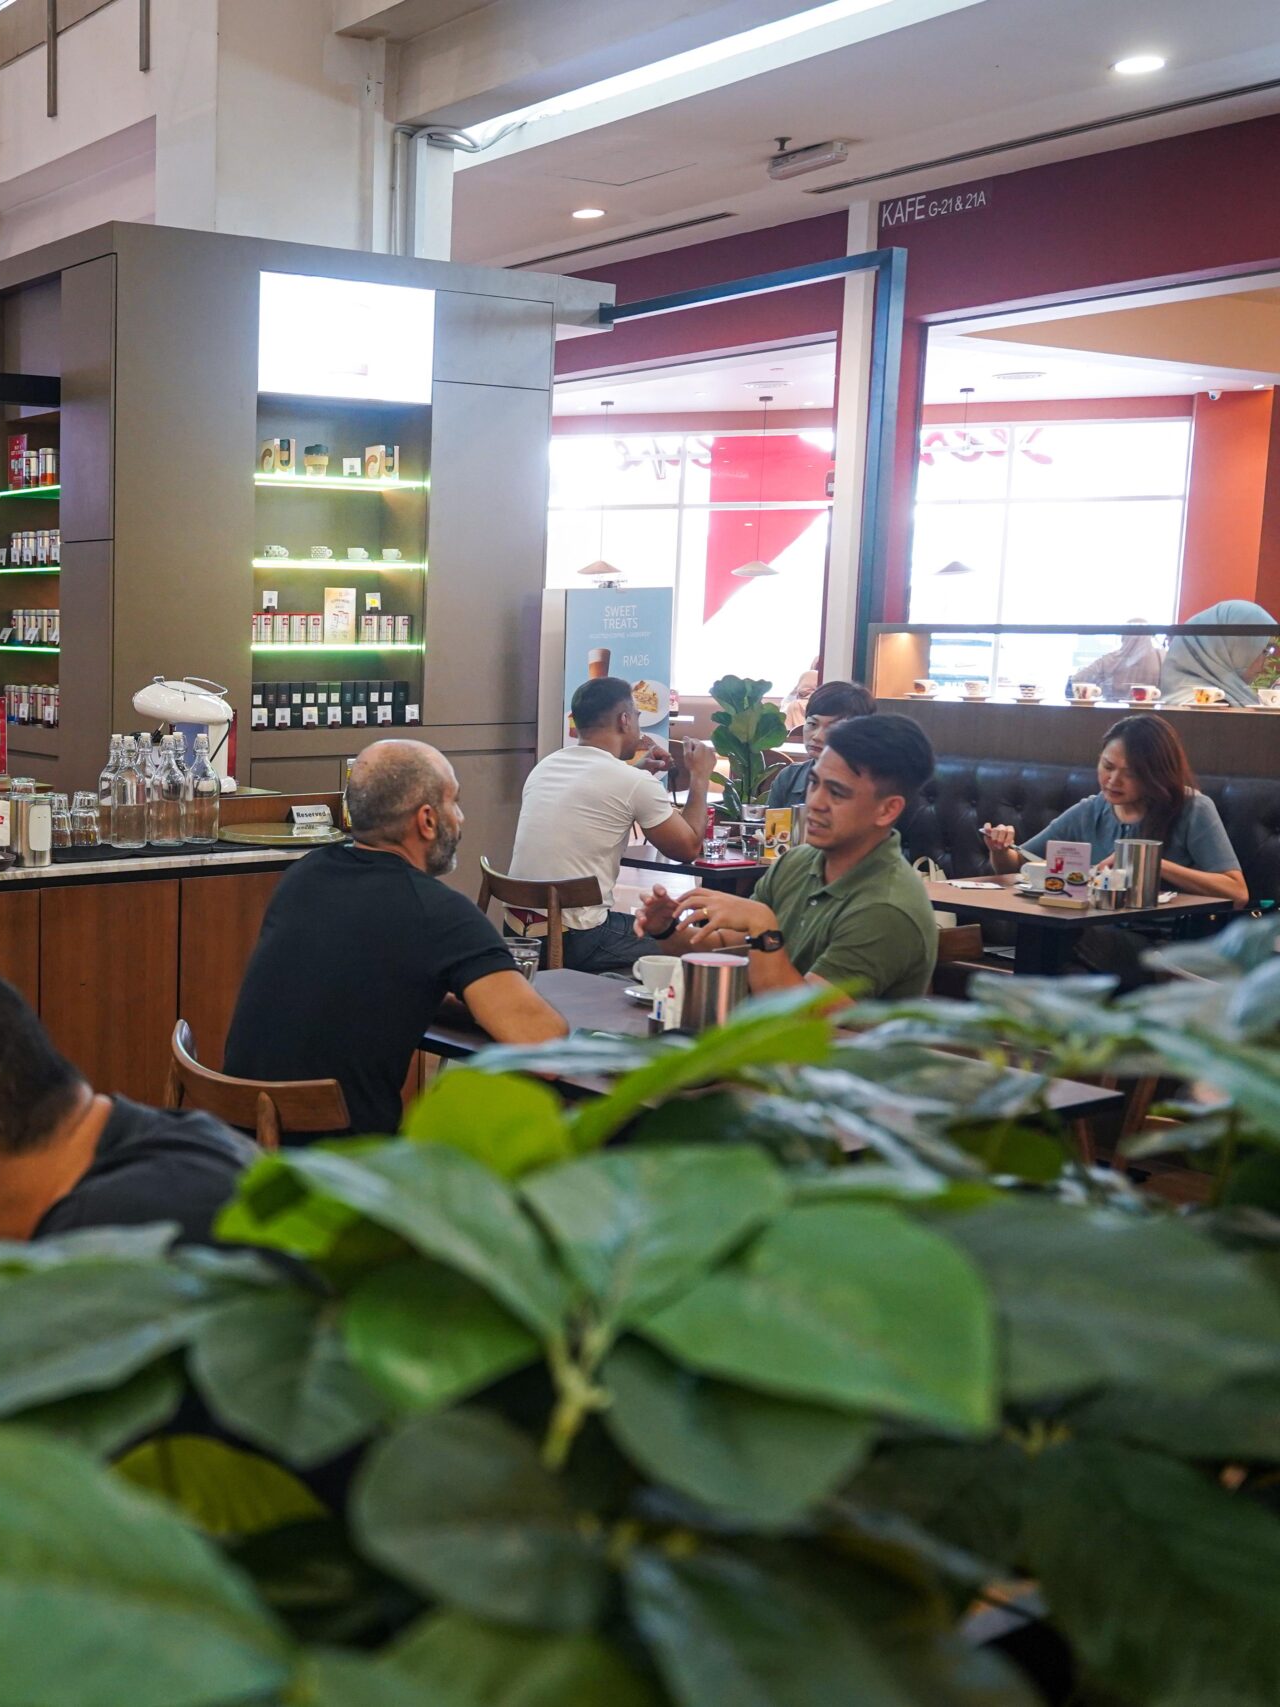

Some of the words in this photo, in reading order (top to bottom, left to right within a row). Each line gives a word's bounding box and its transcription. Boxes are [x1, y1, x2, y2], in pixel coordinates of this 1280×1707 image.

[881, 195, 926, 227] KAFE
[928, 199, 953, 217] G-21
[954, 196, 963, 211] &
[965, 191, 986, 209] 21A
[604, 605, 637, 617] SWEET
[602, 618, 639, 629] TREATS
[623, 655, 650, 666] RM26
